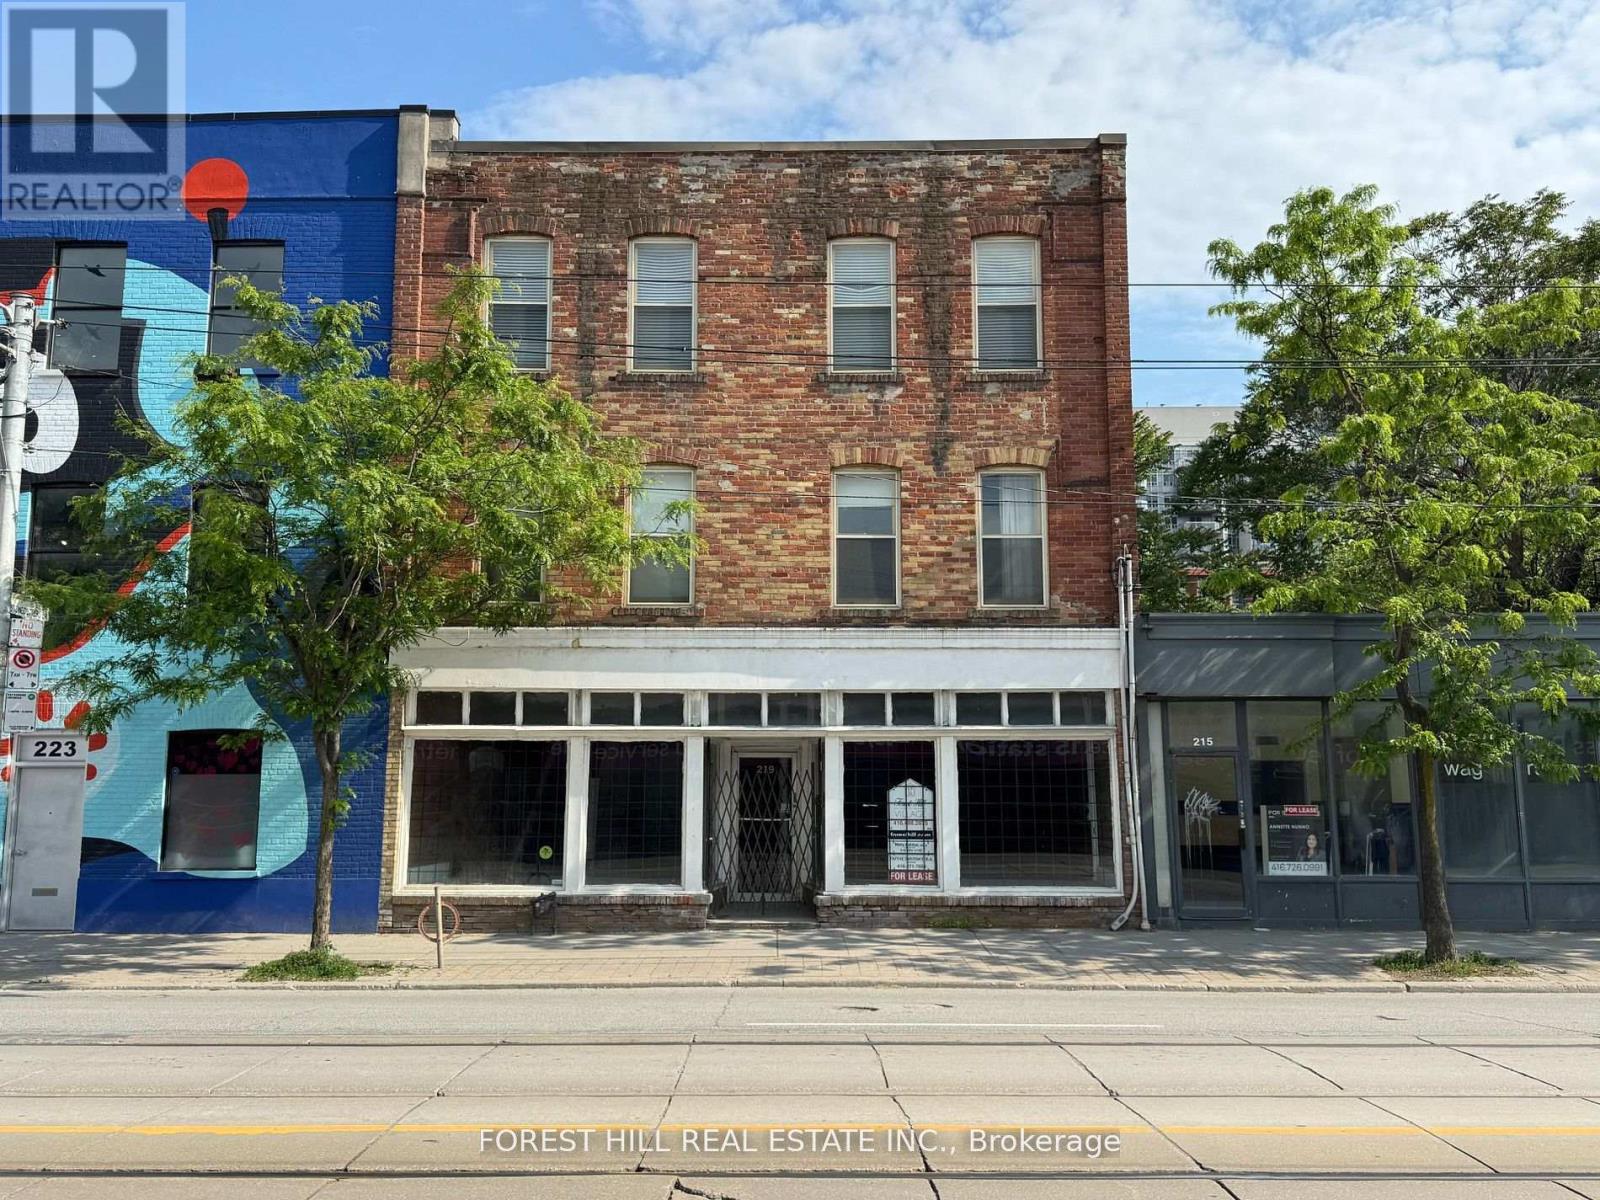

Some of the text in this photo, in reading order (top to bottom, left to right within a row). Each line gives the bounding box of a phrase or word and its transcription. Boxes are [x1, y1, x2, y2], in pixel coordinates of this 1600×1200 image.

[12, 629, 42, 638] STANDING
[1192, 737, 1214, 747] 215
[34, 741, 77, 757] 223
[756, 765, 774, 774] 219
[890, 871, 934, 880] FOR LEASE
